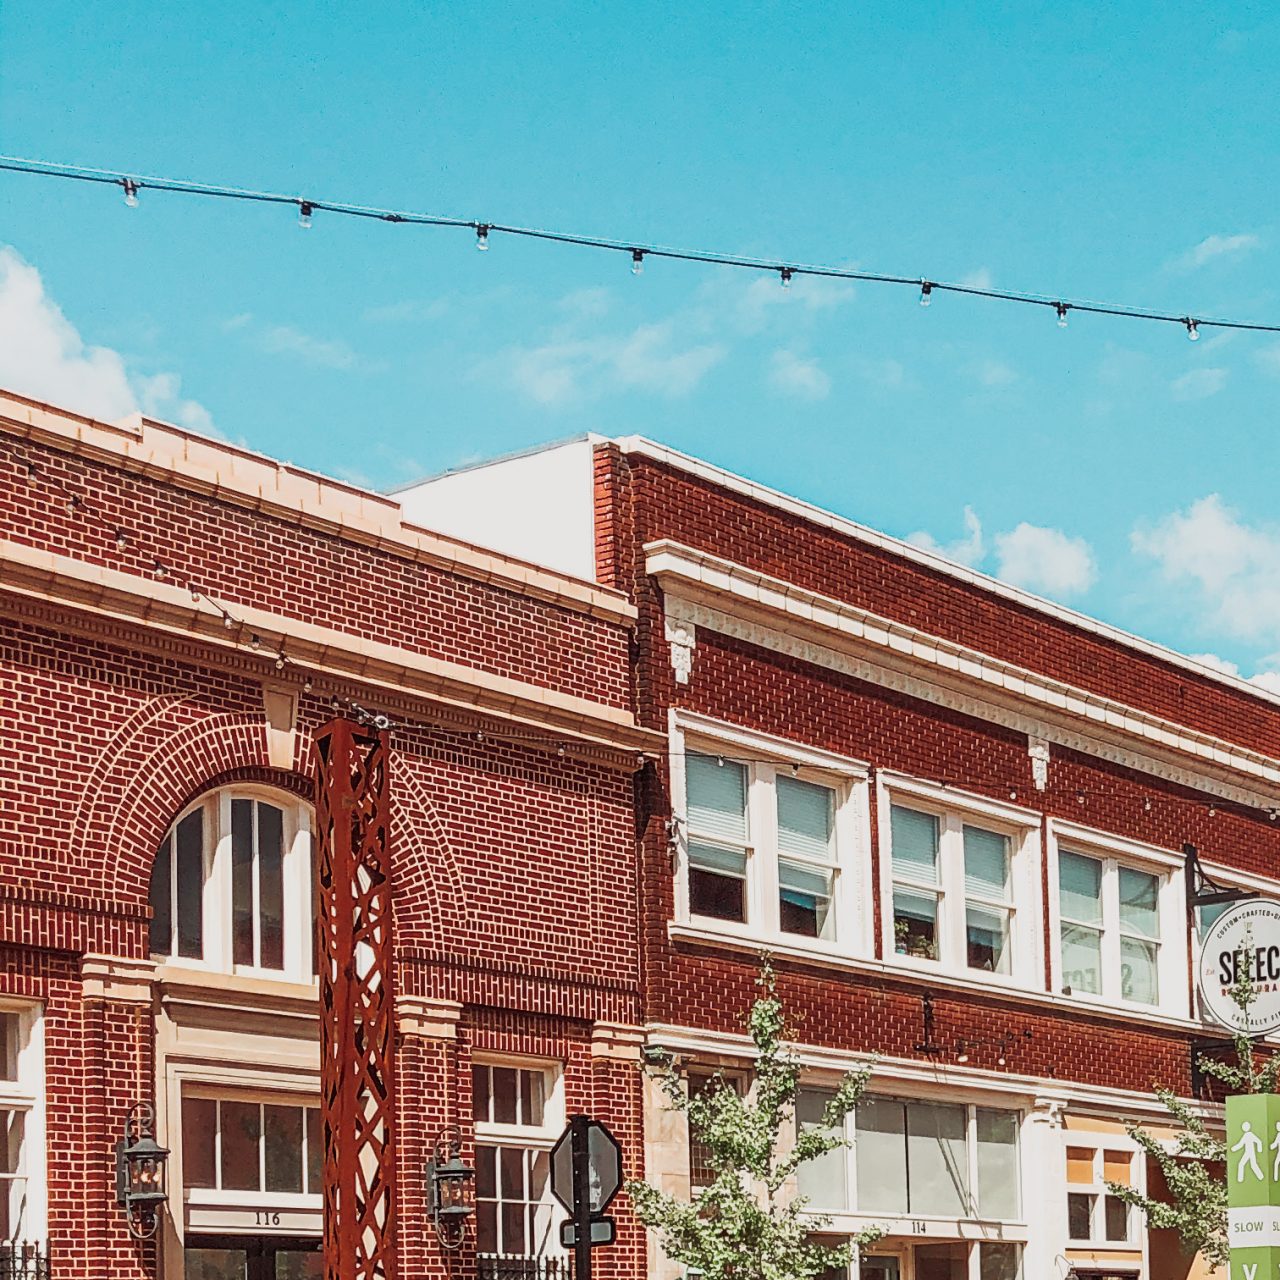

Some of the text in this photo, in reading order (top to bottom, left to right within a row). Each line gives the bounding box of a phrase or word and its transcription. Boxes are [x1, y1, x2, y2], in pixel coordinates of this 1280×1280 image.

[1217, 916, 1239, 939] CUSTOM
[1242, 909, 1271, 919] CRAFTED
[255, 1211, 280, 1226] 116
[912, 1221, 926, 1234] 114
[1234, 1221, 1264, 1233] SLOW
